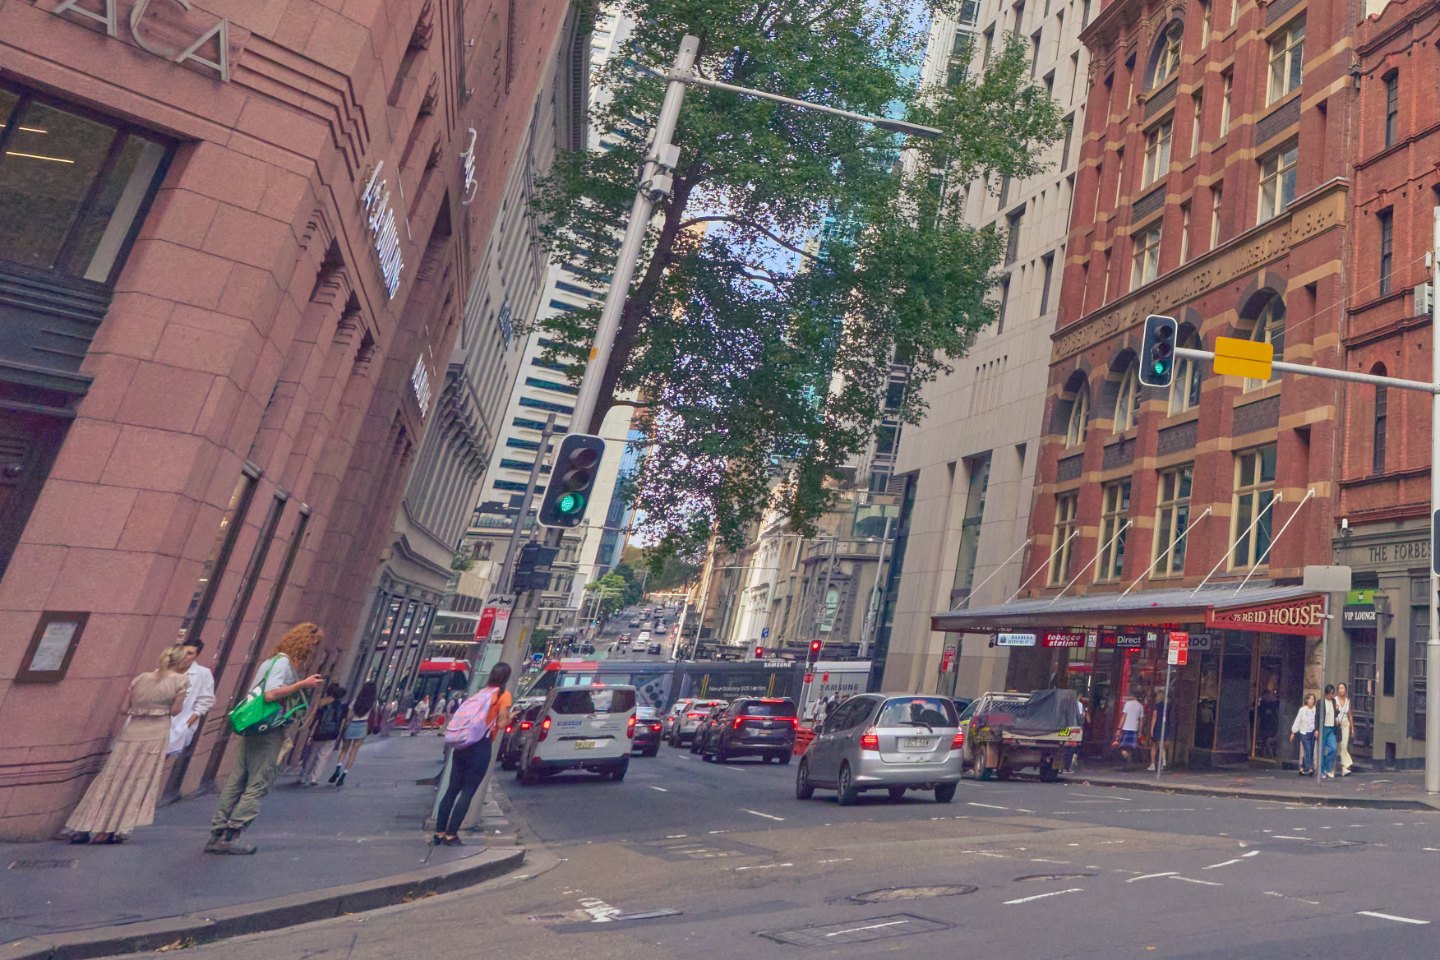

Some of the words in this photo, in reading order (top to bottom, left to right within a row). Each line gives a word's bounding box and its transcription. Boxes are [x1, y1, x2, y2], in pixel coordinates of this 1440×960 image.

[1368, 546, 1388, 563] THE
[1233, 613, 1241, 622] 75
[1242, 611, 1267, 623] REID
[1268, 604, 1321, 626] HOUSE
[1344, 611, 1353, 621] VIP
[1354, 611, 1376, 621] LOUNGE
[1047, 633, 1081, 641] tobacco
[1048, 640, 1079, 648] station
[763, 661, 792, 669] SAMSUNG
[819, 682, 859, 692] SAMSUNG
